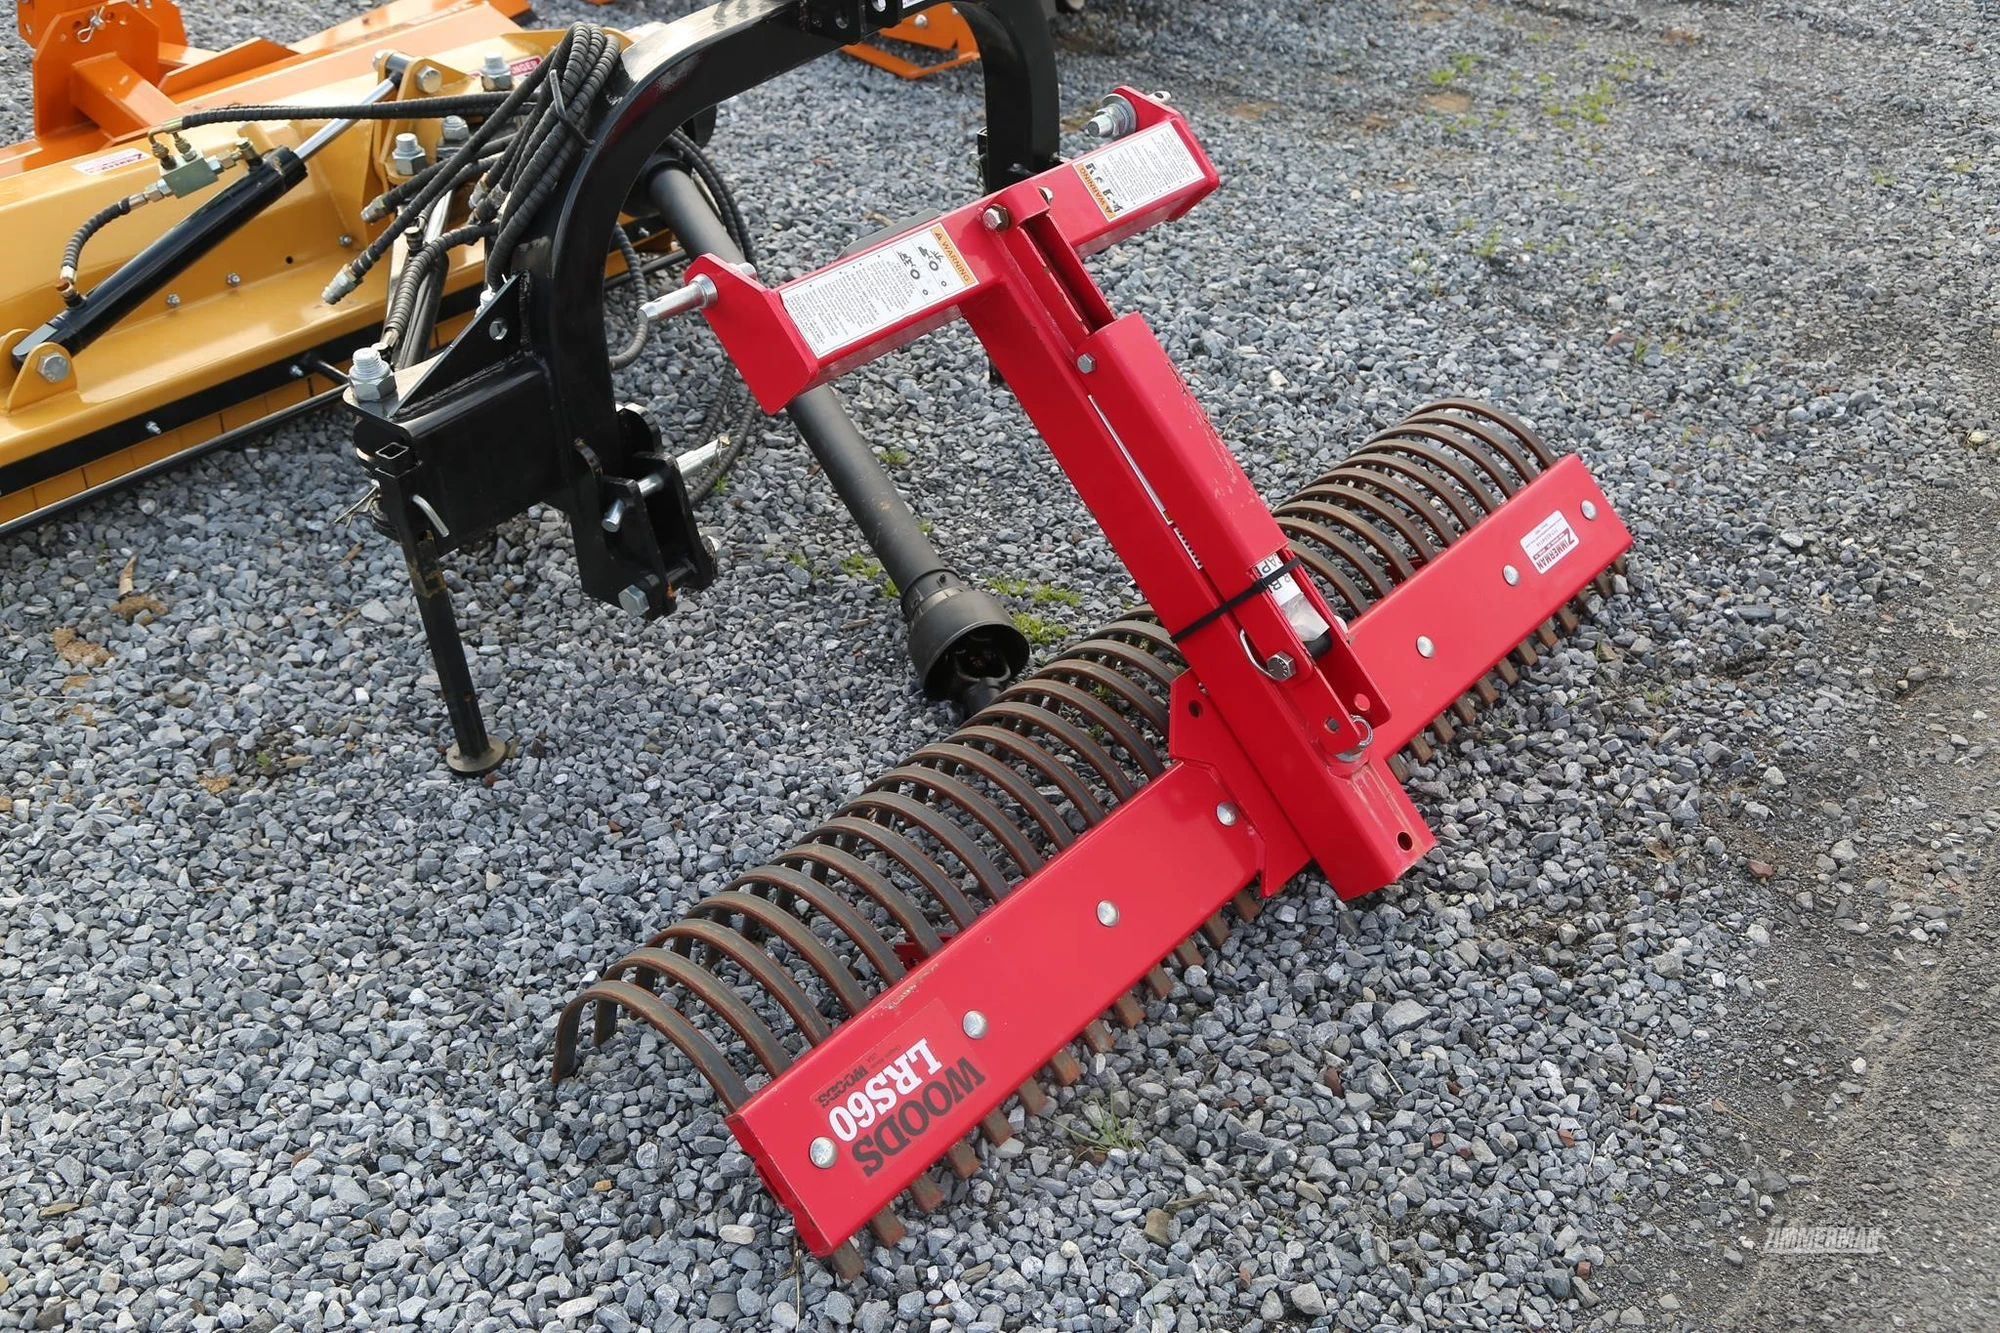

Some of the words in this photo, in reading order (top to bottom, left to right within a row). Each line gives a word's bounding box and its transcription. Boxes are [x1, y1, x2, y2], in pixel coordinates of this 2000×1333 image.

[1080, 167, 1105, 205] WARNING
[942, 241, 970, 281] WARNING
[1535, 528, 1575, 570] ZIMMERMAN
[829, 1038, 942, 1142] LRS60
[852, 1056, 986, 1177] WOODS
